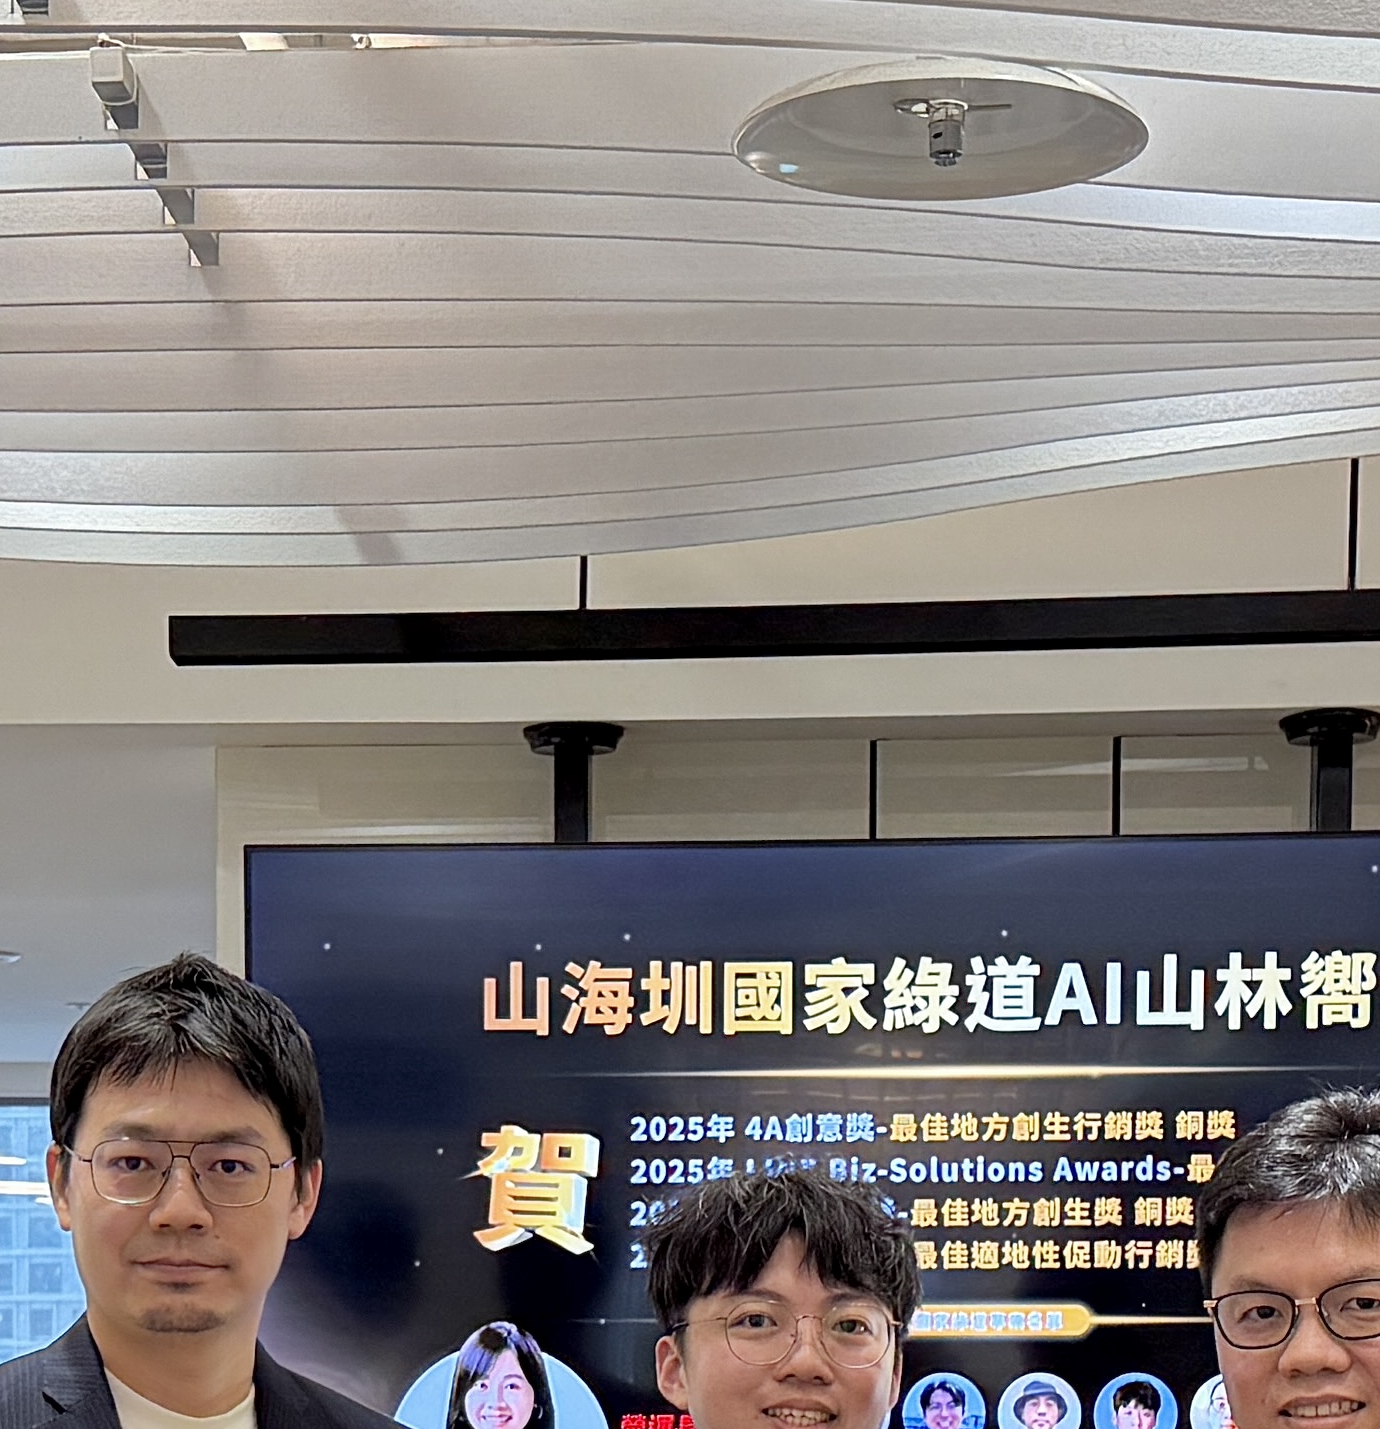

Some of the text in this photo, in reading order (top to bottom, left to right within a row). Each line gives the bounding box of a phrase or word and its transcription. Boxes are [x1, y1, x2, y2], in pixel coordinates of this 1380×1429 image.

[629, 1113, 735, 1144] 2025年
[1175, 1109, 1236, 1141] 銅獎
[629, 1156, 735, 1186] 2025年
[472, 1124, 601, 1254] 賀
[1134, 1196, 1194, 1227] 銅獎
